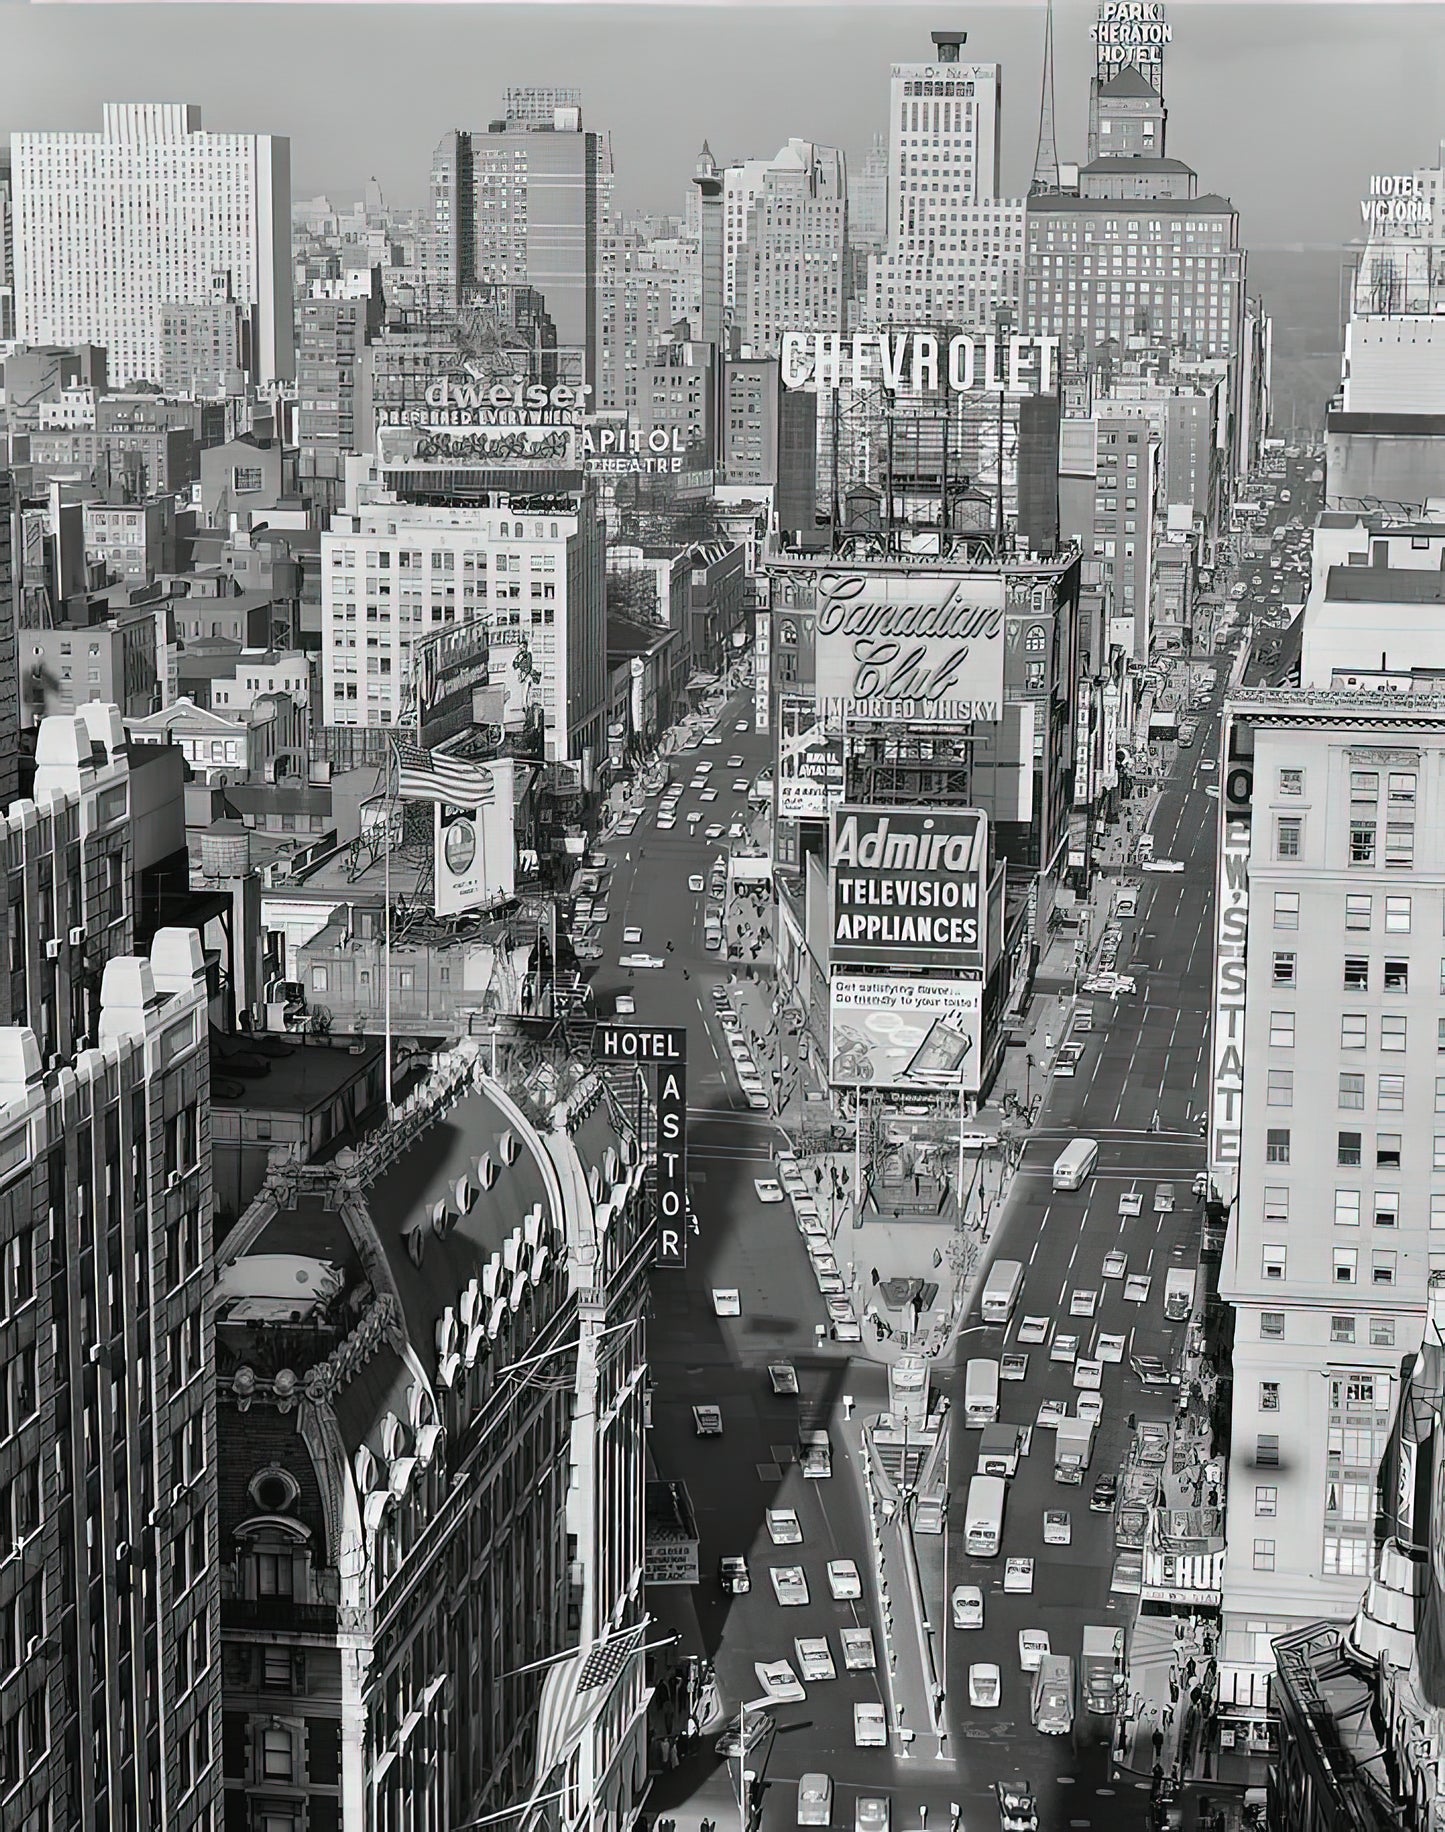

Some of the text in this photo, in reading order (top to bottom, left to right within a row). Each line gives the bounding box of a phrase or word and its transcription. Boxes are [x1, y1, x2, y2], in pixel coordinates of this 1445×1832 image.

[1089, 22, 1173, 43] SHERATON
[1098, 45, 1161, 63] HOTEL
[1370, 176, 1422, 198] HOTEL
[1361, 200, 1432, 221] VICTORIA
[782, 331, 1059, 392] CHEVROLET
[583, 428, 686, 453] APITOL
[588, 457, 682, 473] THEATRE
[816, 574, 1004, 639] Canadian
[854, 639, 968, 700] Club
[822, 697, 997, 720] IMPORTED WHISKY
[831, 815, 981, 872] Admiral
[1223, 726, 1254, 943] LOEW'S
[838, 879, 977, 908] TELEVISION
[836, 914, 977, 944] APPLIANCES
[836, 982, 856, 991] Get
[901, 996, 912, 1005] to
[604, 1031, 679, 1057] HOTEL
[1216, 962, 1246, 1163] STATE
[662, 1074, 680, 1256] ASTOR
